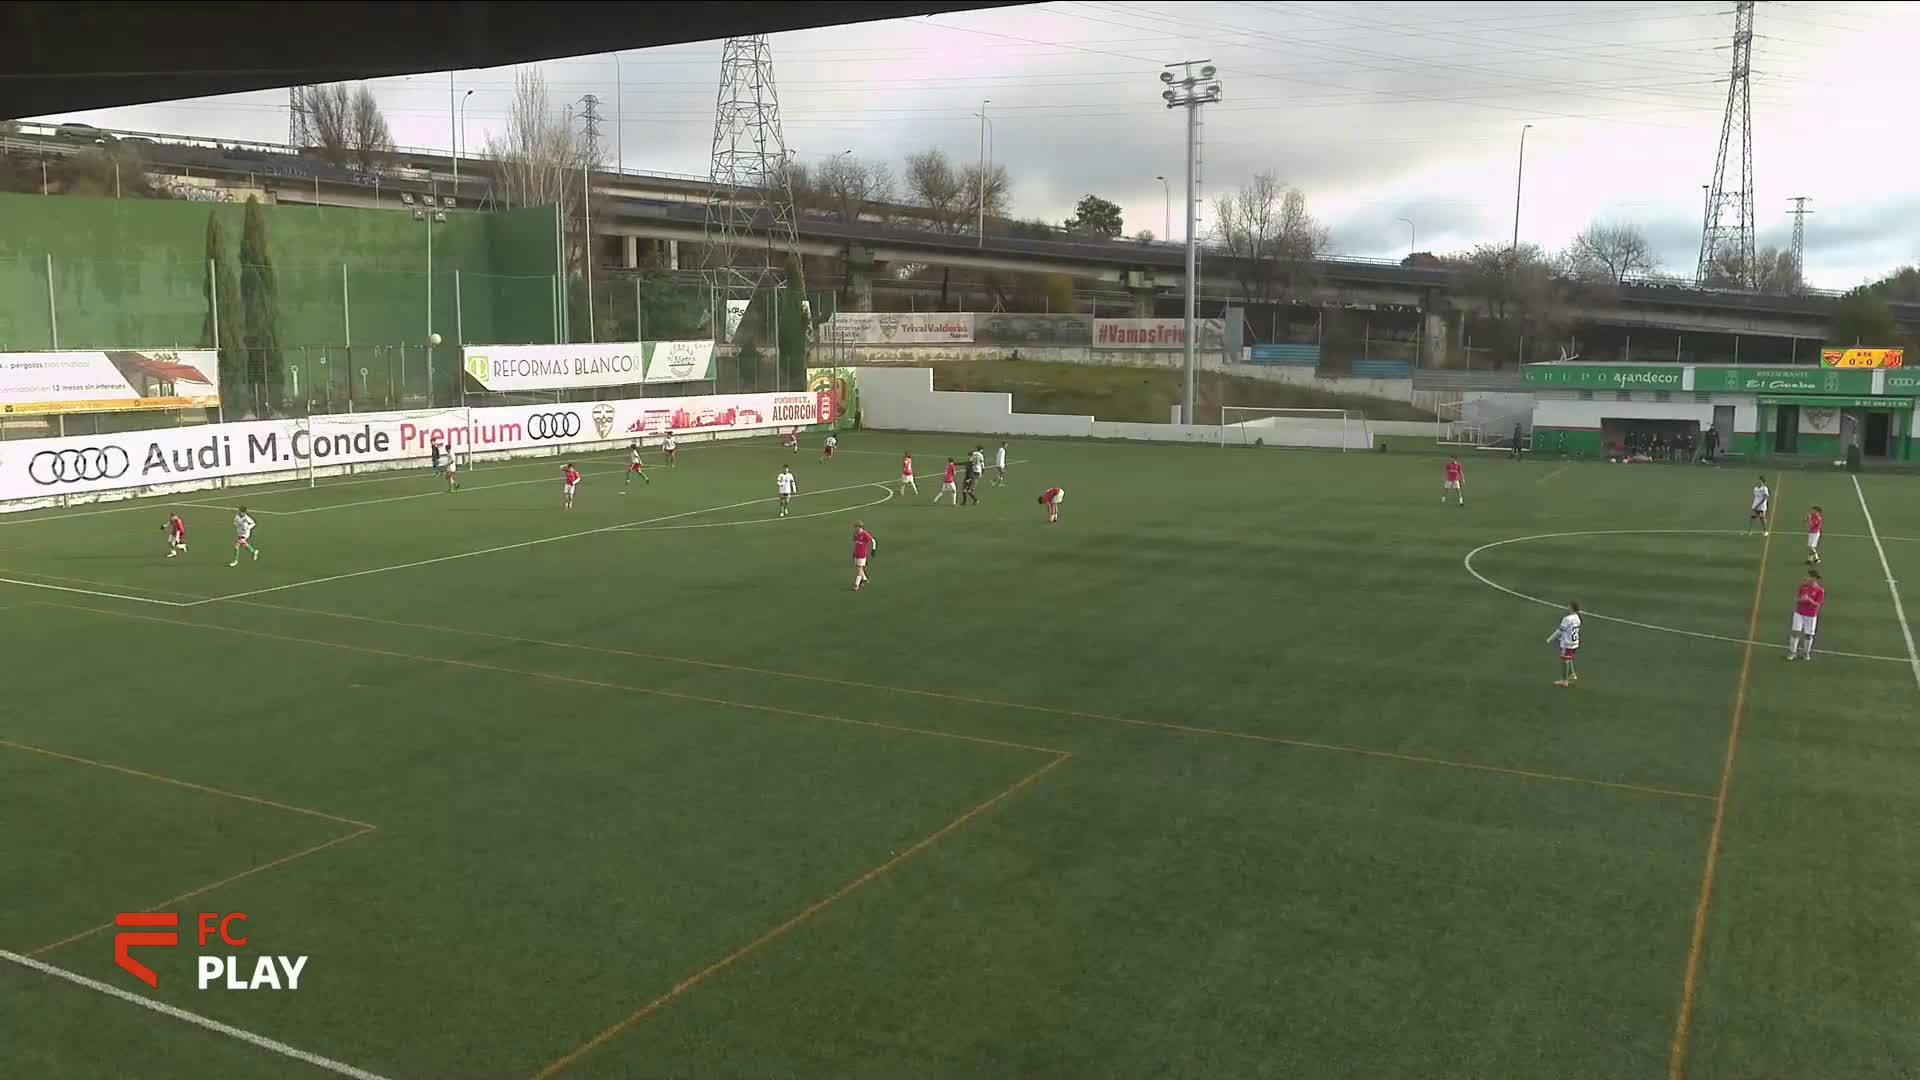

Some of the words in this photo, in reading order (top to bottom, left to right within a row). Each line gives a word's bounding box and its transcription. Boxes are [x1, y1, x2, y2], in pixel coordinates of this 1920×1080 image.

[493, 358, 569, 377] REFORMAS
[575, 354, 633, 375] BLANCO
[772, 400, 816, 421] ALCORCÓN
[400, 419, 522, 450] Premium
[142, 435, 232, 476] Audi
